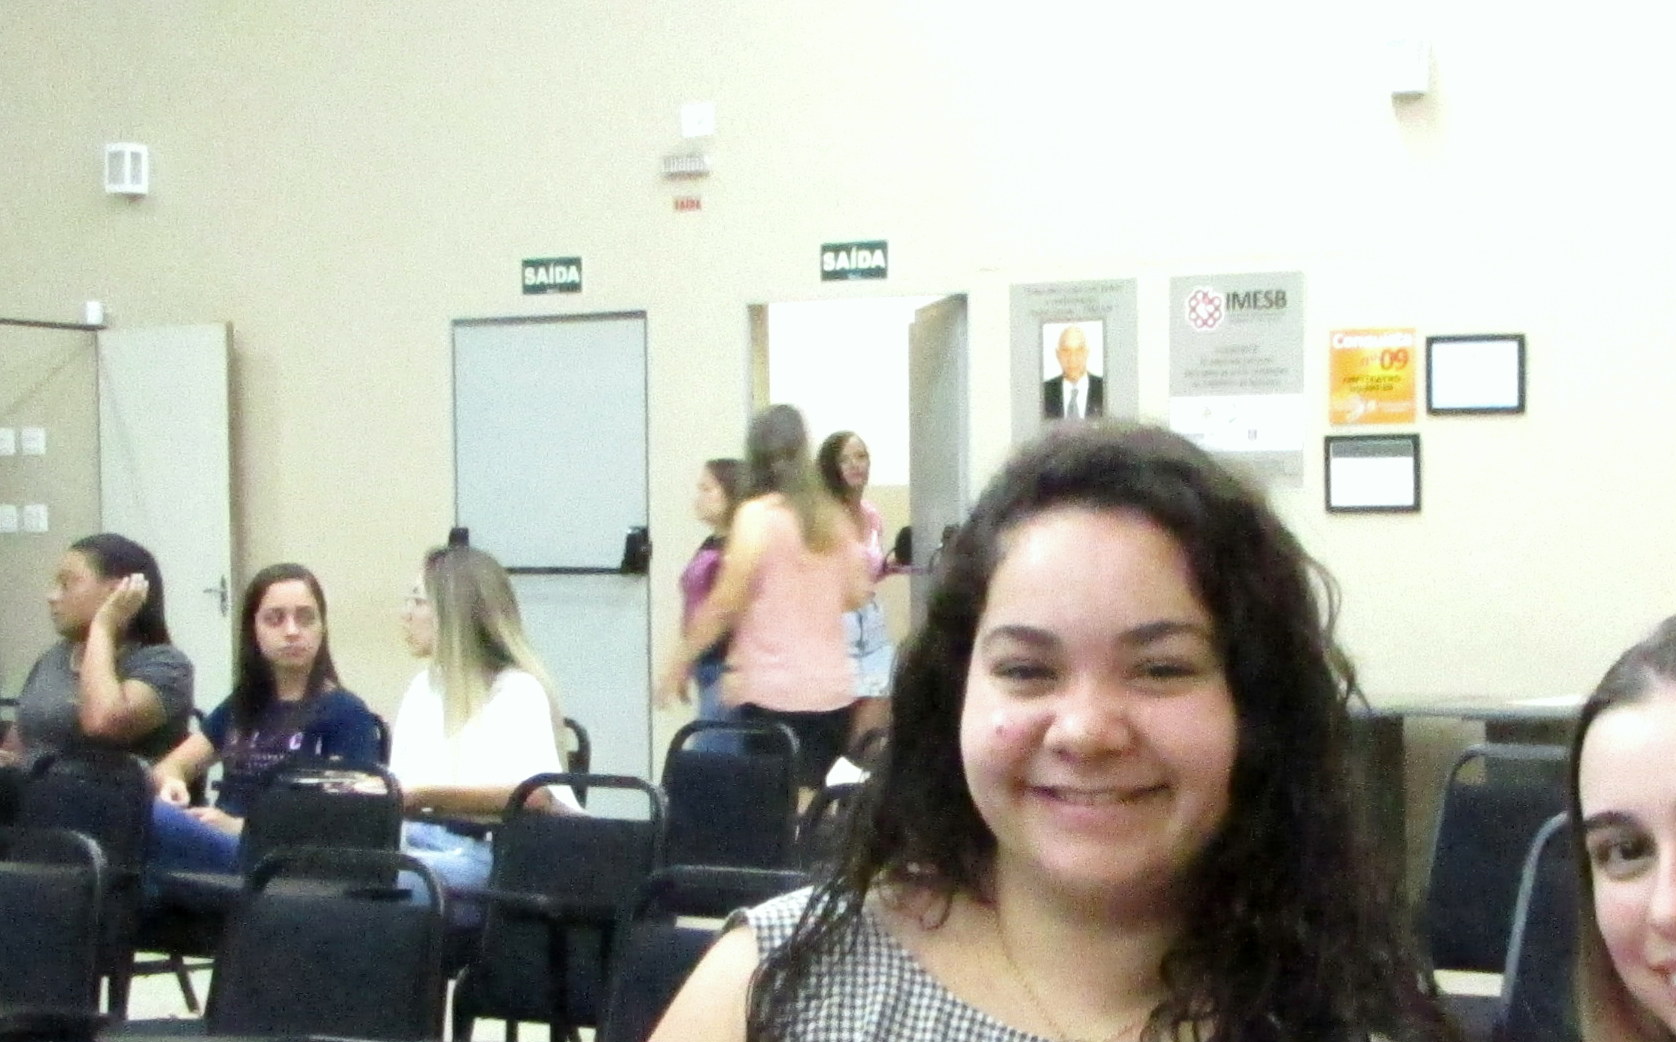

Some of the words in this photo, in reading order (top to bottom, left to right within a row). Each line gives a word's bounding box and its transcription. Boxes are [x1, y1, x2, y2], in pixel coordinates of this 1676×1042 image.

[823, 246, 886, 272] SAÍDA
[524, 263, 580, 285] SAÍDA
[1225, 289, 1288, 311] IMESB
[1380, 348, 1410, 371] 09
